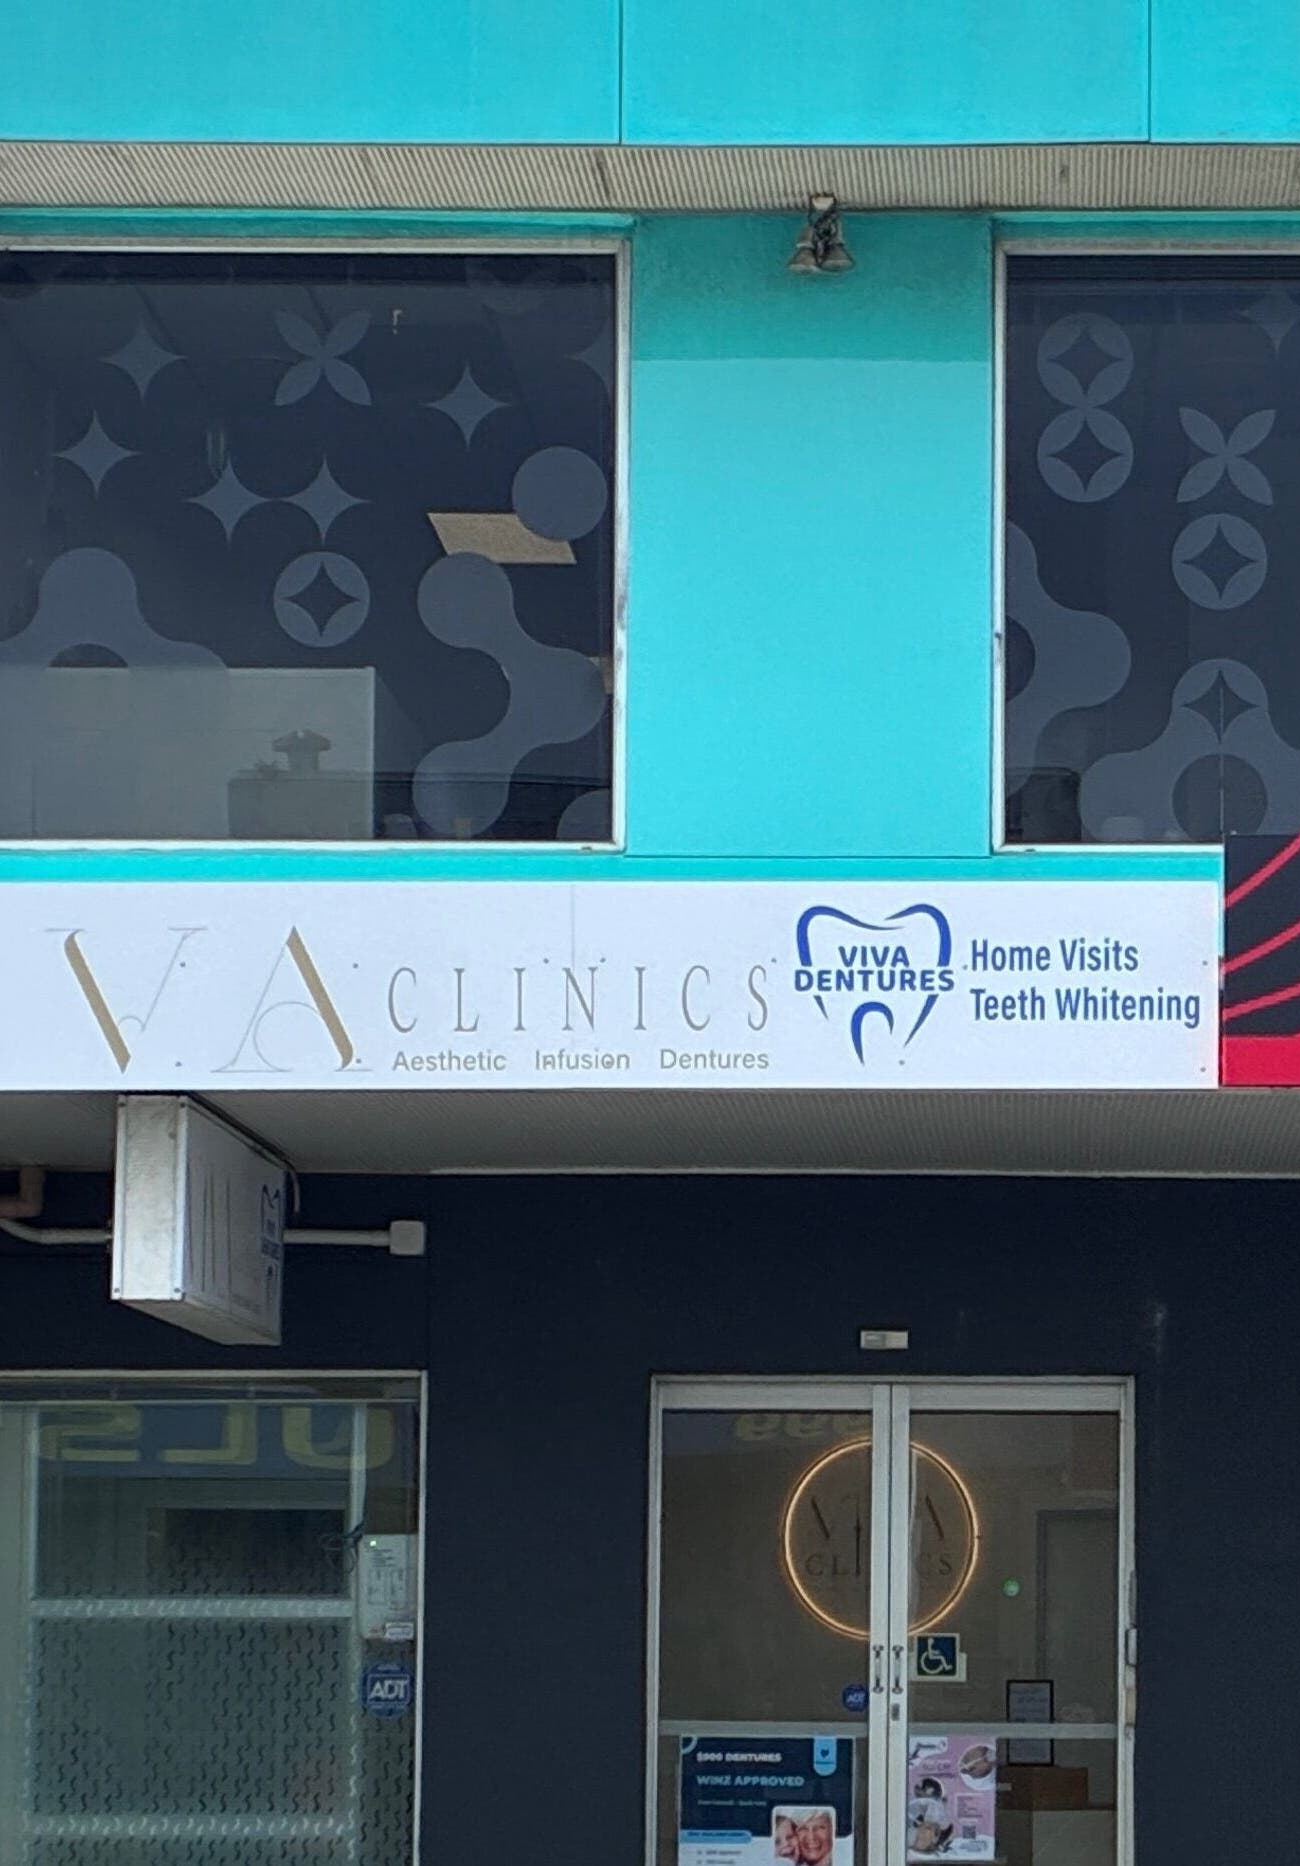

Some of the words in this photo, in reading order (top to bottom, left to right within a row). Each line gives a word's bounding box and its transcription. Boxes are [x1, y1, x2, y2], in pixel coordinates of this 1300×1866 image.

[838, 946, 910, 968] VIVA
[971, 939, 1052, 972] Home
[1060, 937, 1139, 972] Visits
[794, 969, 955, 992] DENTURES
[387, 964, 769, 1034] CLINICS
[970, 988, 1046, 1021] Teeth
[1055, 987, 1201, 1029] Whitening
[392, 1049, 507, 1073] Aesthetic
[535, 1049, 631, 1072] Infusion
[660, 1048, 770, 1072] Dentures
[368, 1679, 407, 1700] ADT
[734, 1775, 805, 1787] APPROVED
